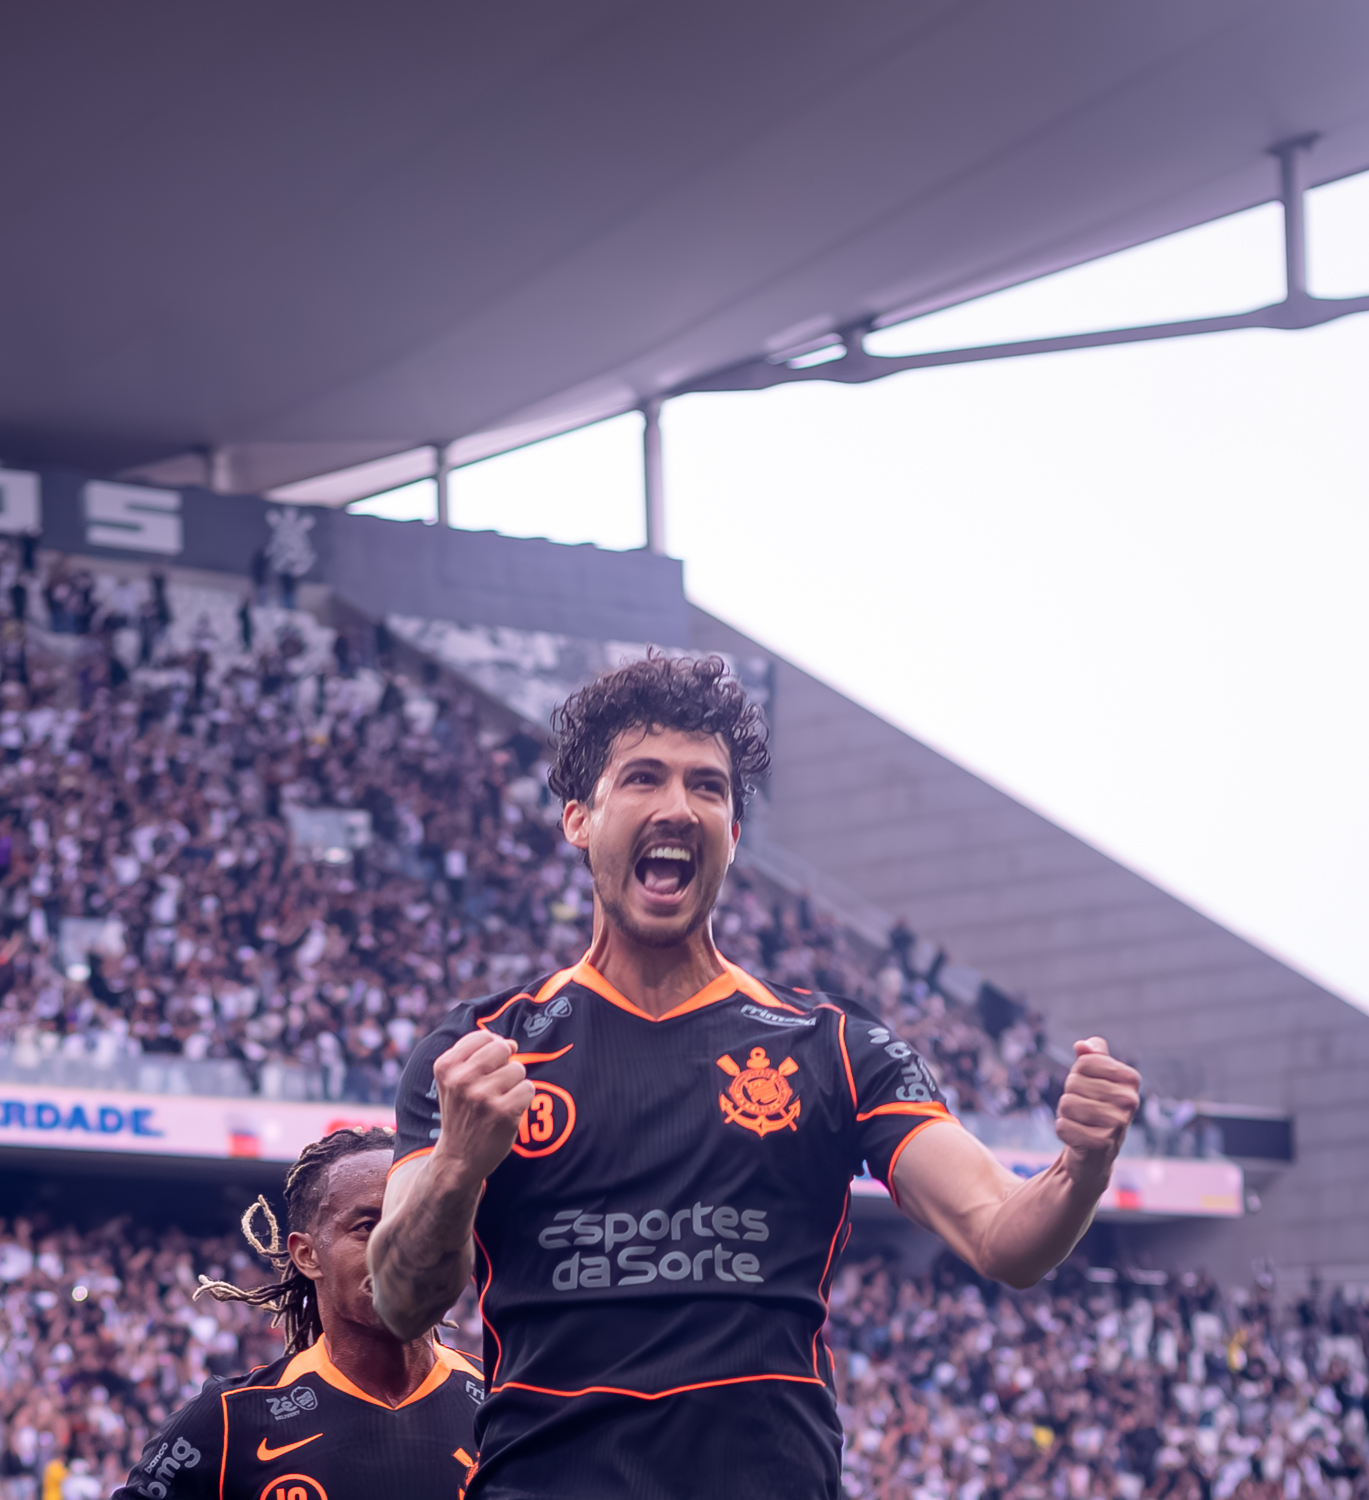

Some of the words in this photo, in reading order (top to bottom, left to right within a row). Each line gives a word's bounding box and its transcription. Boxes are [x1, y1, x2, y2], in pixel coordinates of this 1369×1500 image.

[519, 1093, 554, 1144] 13
[538, 1201, 770, 1253] Esportes
[144, 1442, 168, 1475] banco
